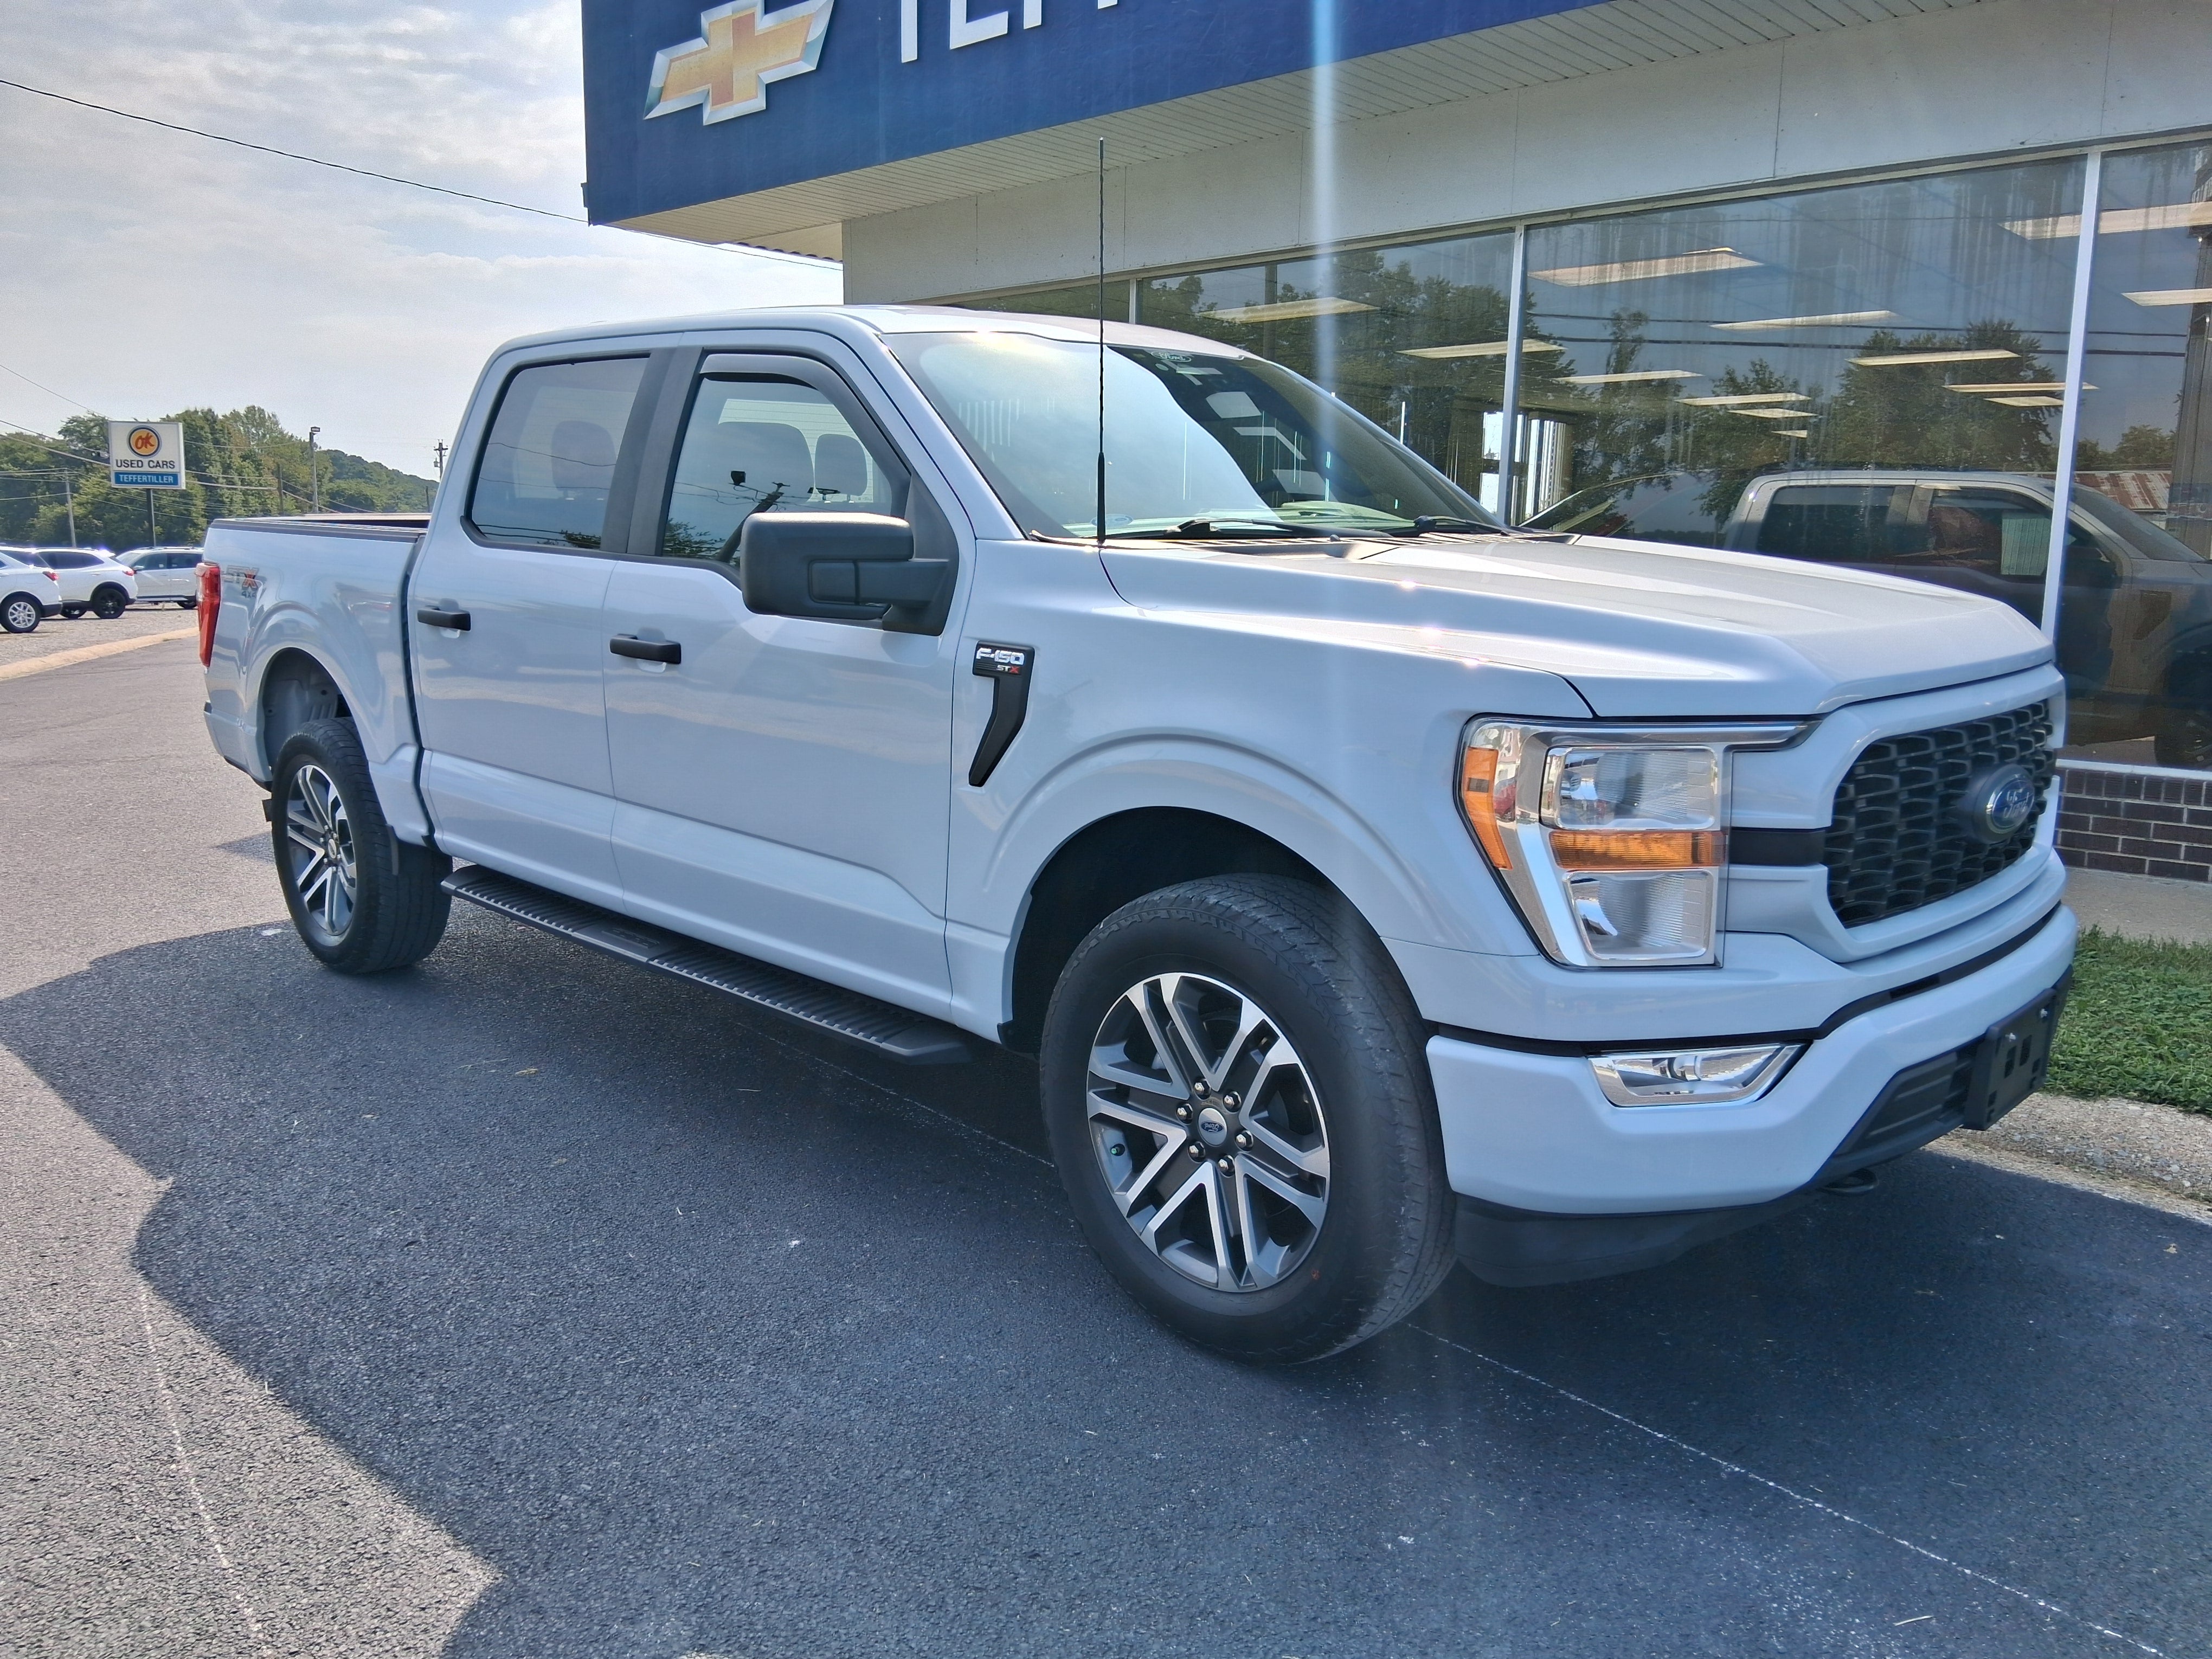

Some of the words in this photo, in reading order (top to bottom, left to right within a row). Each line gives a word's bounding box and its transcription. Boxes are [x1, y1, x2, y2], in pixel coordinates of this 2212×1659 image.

[134, 432, 155, 449] OK
[115, 459, 143, 468] USED
[148, 460, 175, 469] CARS
[119, 474, 173, 483] TEFFERTILLER
[976, 647, 1025, 665] F-150
[996, 665, 1020, 673] STX
[1204, 1123, 1220, 1132] Ford
